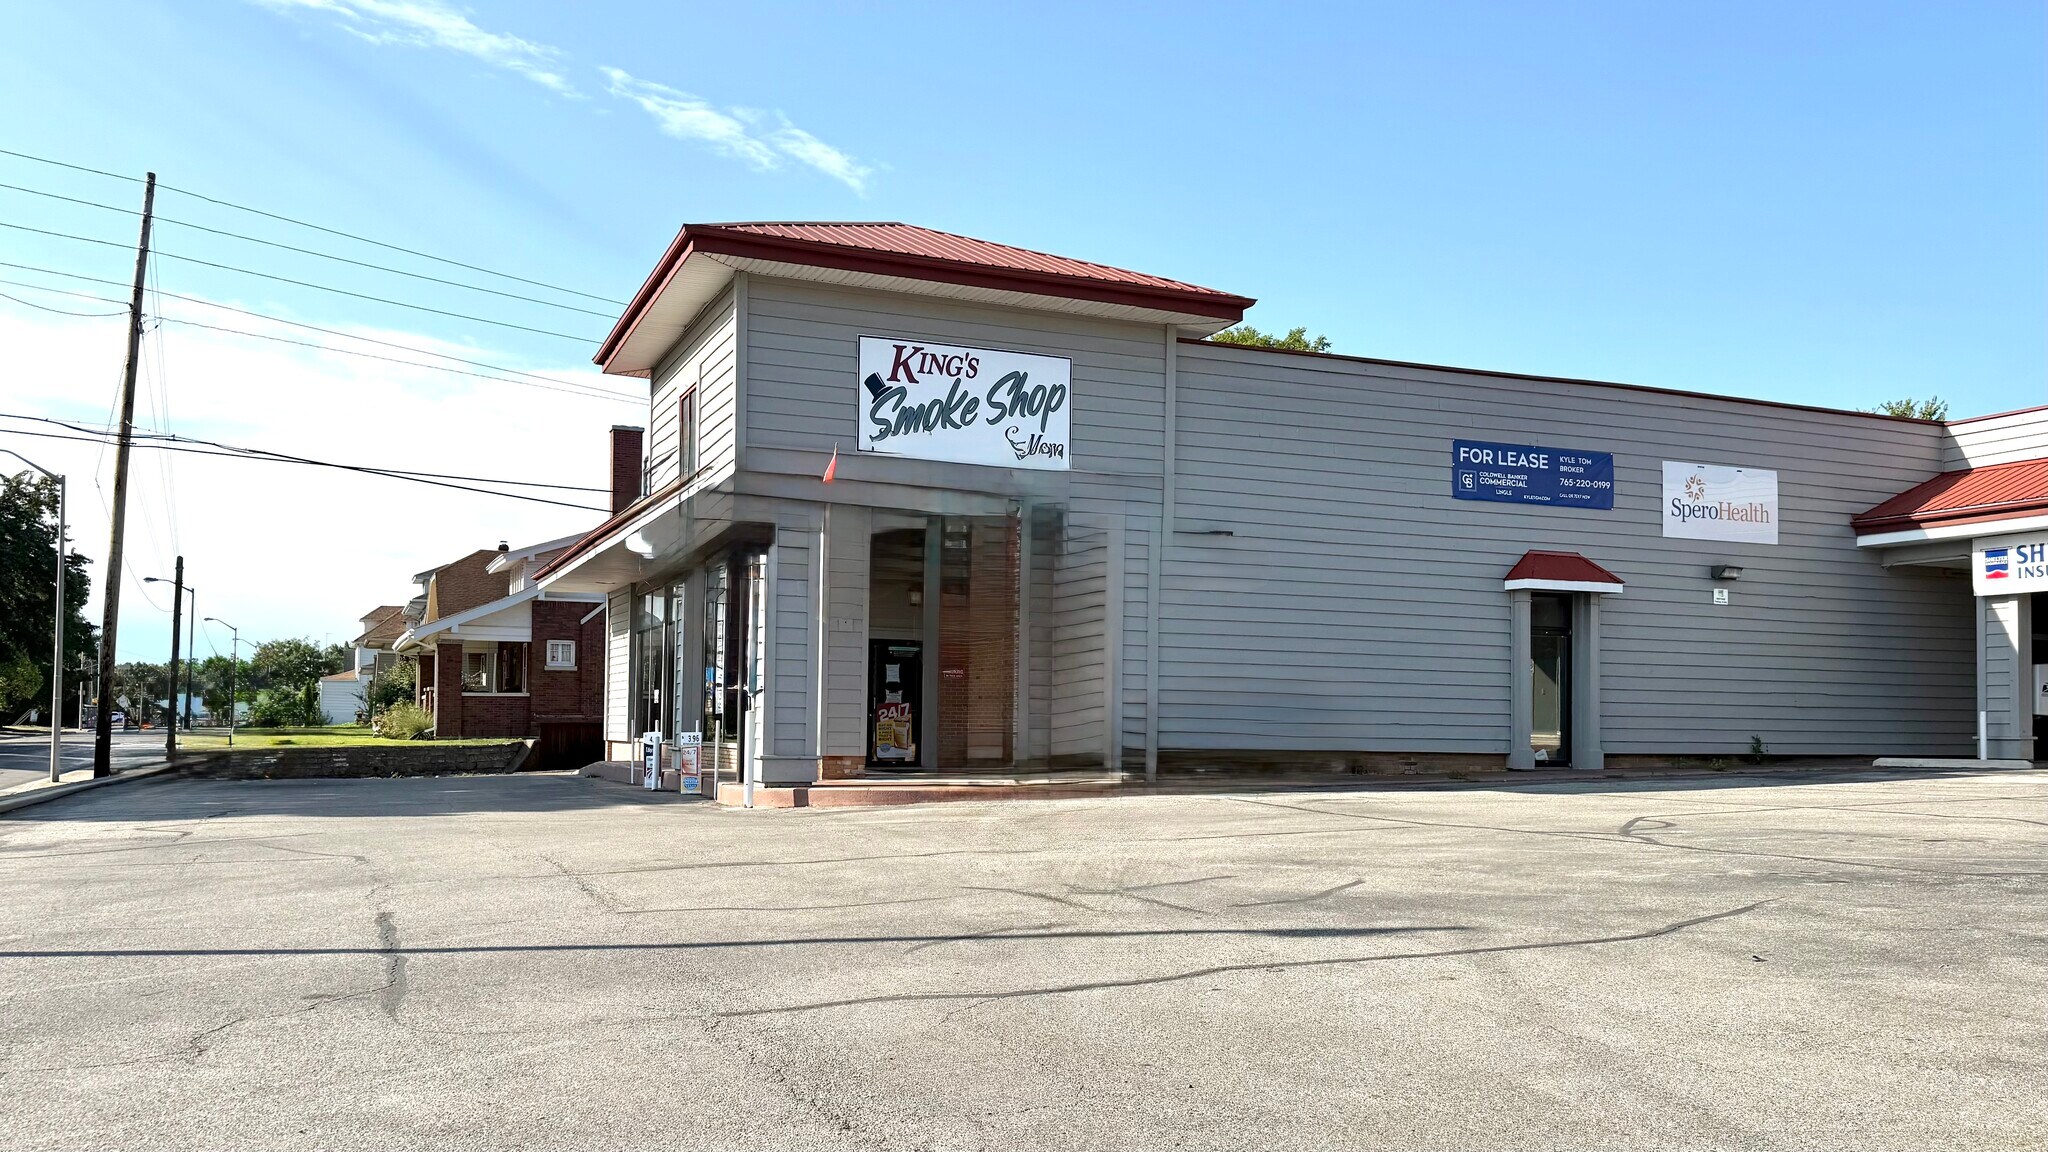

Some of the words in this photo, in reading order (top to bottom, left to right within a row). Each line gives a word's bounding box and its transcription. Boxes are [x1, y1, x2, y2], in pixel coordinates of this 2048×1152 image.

[887, 344, 980, 384] KING'S
[869, 377, 980, 442] Smoke
[986, 370, 1067, 433] Shop
[1460, 447, 1493, 465] FOR
[1498, 450, 1549, 469] LEASE
[1559, 456, 1576, 464] KYLE
[1578, 457, 1592, 465] TOM
[1479, 471, 1506, 479] COLDWELL
[1507, 473, 1528, 481] BANKER
[1559, 465, 1584, 474] BROKER
[1479, 477, 1528, 488] COMMERCIAL
[1671, 497, 1770, 524] SperoHealth
[2018, 564, 2048, 579] INS
